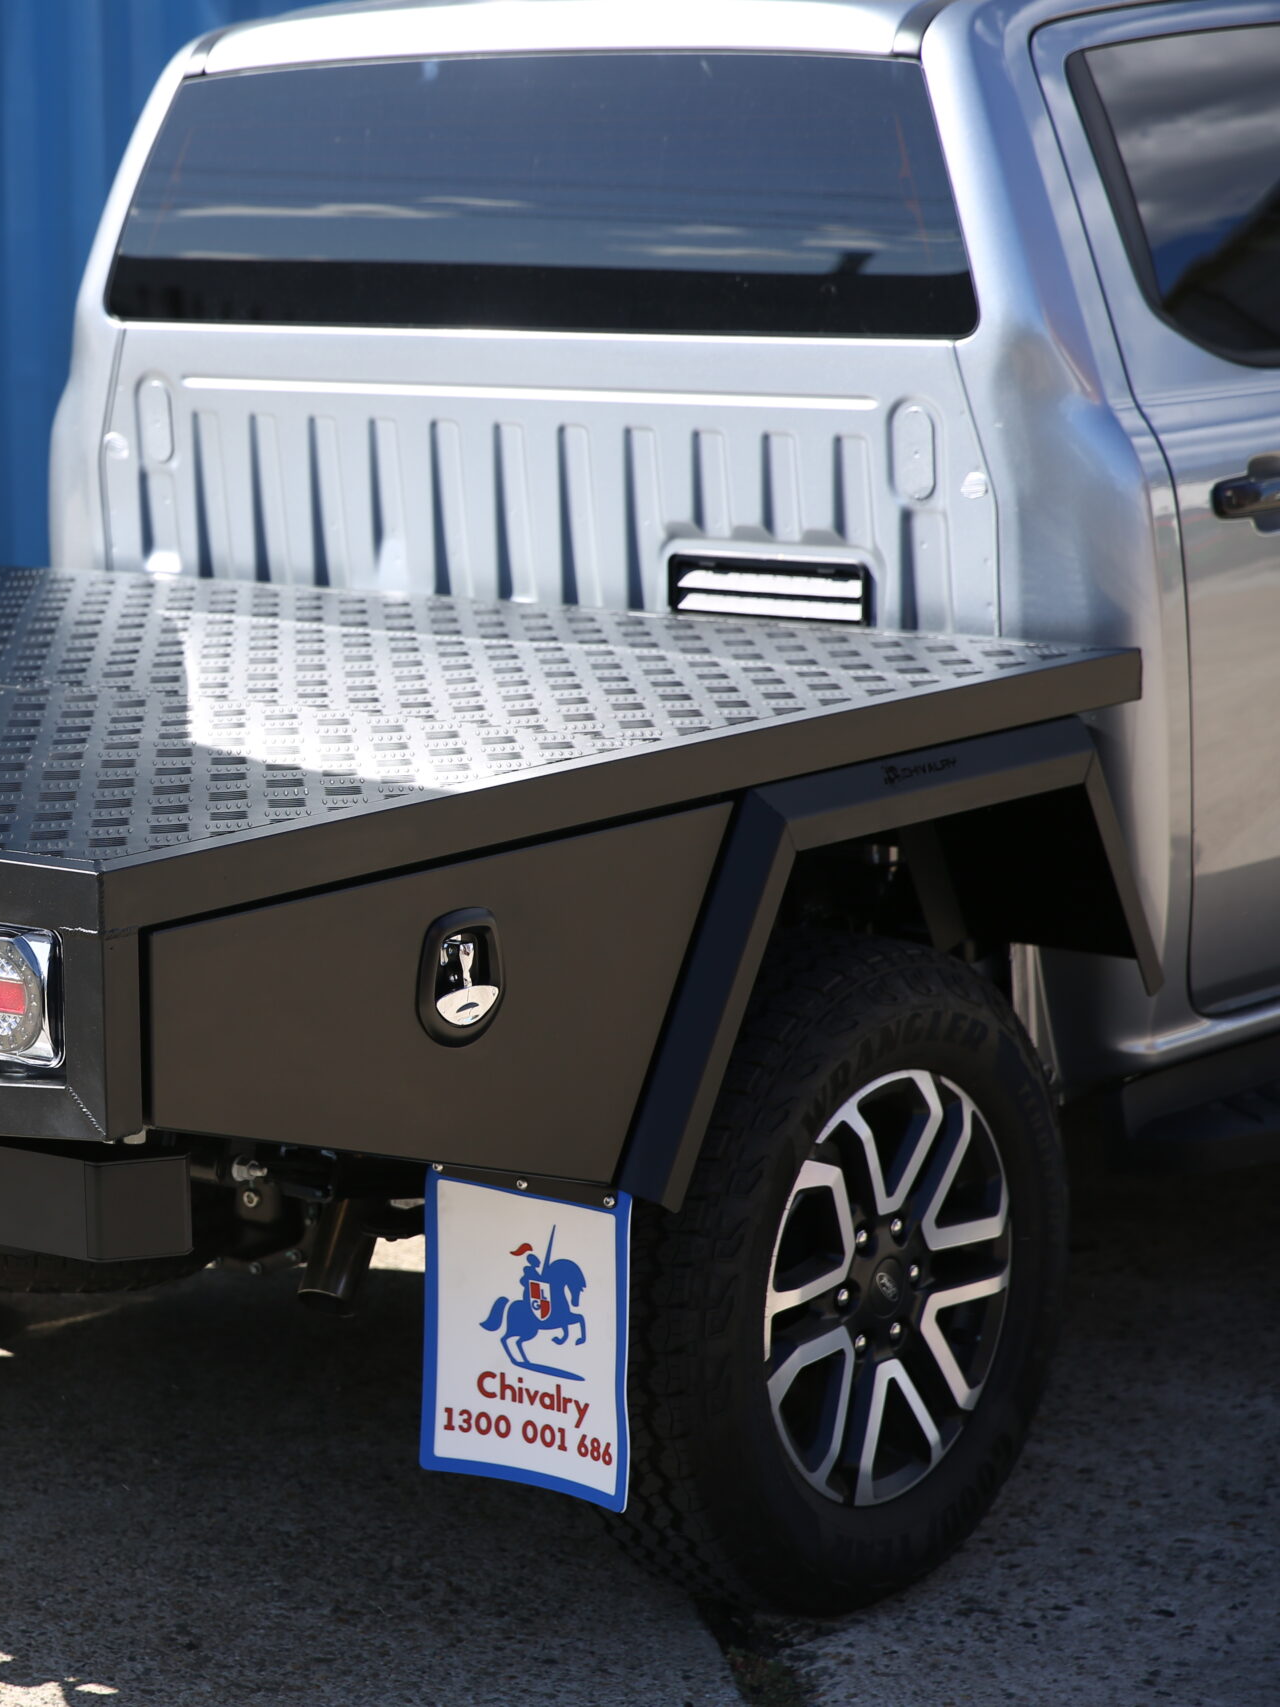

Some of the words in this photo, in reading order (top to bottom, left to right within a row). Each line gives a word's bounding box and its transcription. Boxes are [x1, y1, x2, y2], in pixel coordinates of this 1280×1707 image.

[801, 1010, 990, 1135] WRANGLER
[477, 1371, 589, 1428] Chivalry
[443, 1407, 511, 1438] 1300
[521, 1419, 567, 1452] 001
[577, 1434, 613, 1466] 686
